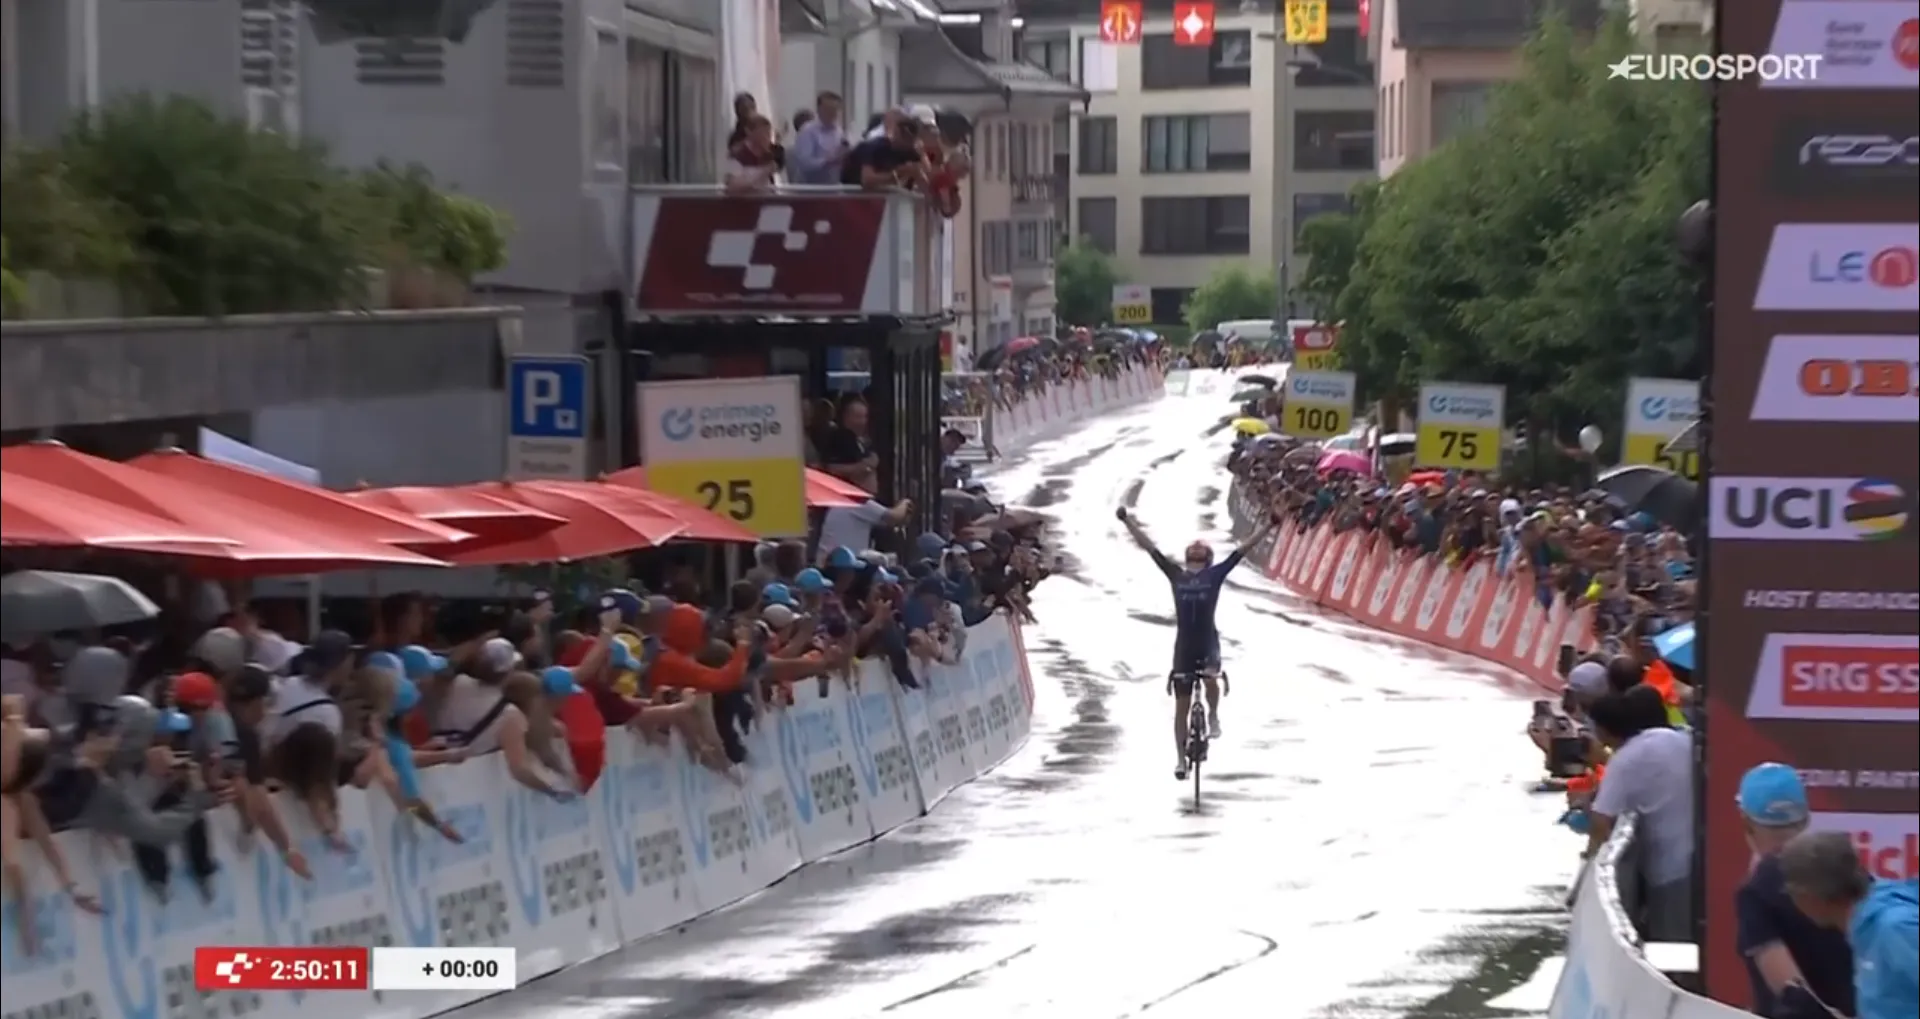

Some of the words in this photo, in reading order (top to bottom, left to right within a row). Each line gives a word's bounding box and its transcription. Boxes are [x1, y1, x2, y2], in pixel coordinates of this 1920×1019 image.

[1118, 304, 1147, 319] 200
[1800, 359, 1918, 396] OB
[523, 369, 562, 426] P
[700, 417, 781, 443] energie
[1296, 406, 1339, 432] 100
[1440, 431, 1477, 460] 75
[696, 479, 754, 521] 25
[1726, 487, 1831, 529] UCI
[1744, 588, 1813, 608] HOST
[1791, 661, 1869, 692] SRG
[1876, 663, 1918, 693] SS
[1797, 769, 1850, 787] EDIA
[1857, 830, 1918, 880] ick
